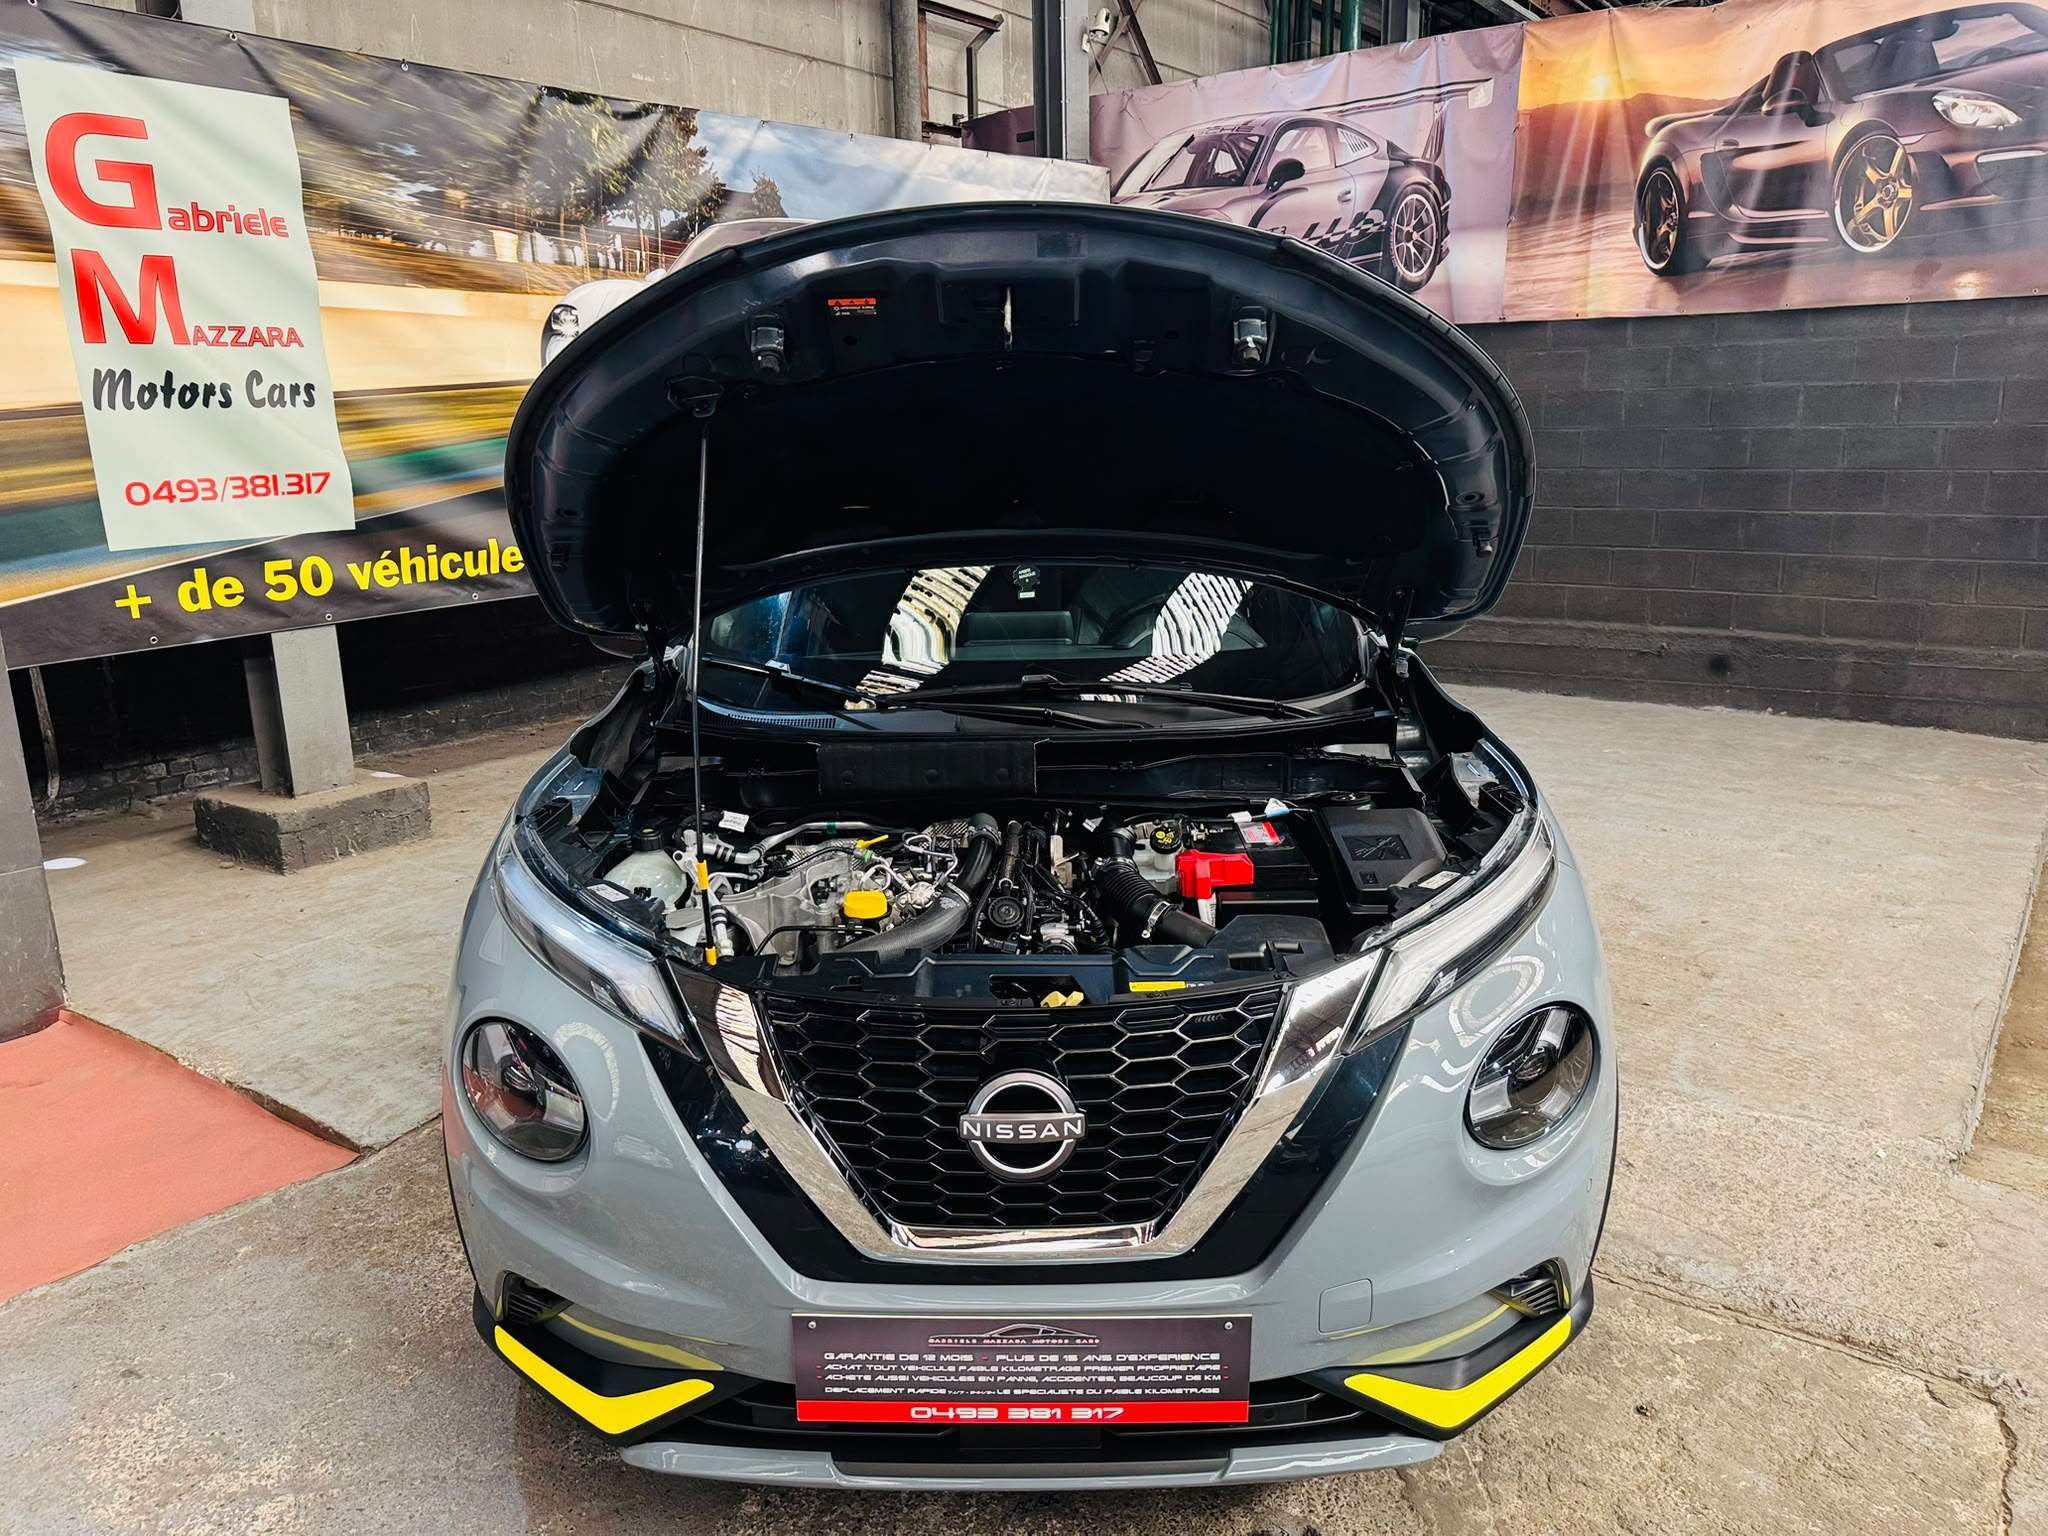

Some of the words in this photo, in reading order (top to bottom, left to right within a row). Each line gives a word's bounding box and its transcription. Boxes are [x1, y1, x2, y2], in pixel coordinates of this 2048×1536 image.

[45, 112, 289, 238] Gabriele
[70, 248, 305, 347] MAZZARA
[93, 368, 232, 411] Motors
[245, 369, 316, 408] Cars
[125, 472, 331, 507] 0493/381.317
[177, 567, 245, 613] de
[264, 556, 334, 602] 50
[346, 538, 526, 590] véhicule
[961, 1119, 1083, 1139] NISSAN
[824, 1352, 896, 1361] GARANTIE
[940, 1354, 974, 1362] MOIS
[996, 1354, 1035, 1362] PLUS
[1039, 1354, 1059, 1362] DE
[1062, 1354, 1078, 1362] 15
[1082, 1354, 1112, 1362] ANS
[1116, 1353, 1220, 1361] D'EXPERIENCE
[1145, 1387, 1220, 1395] KILOMETRAGE
[911, 1407, 999, 1419] 0493
[1008, 1407, 1062, 1419] 381
[1071, 1407, 1124, 1419] 317
